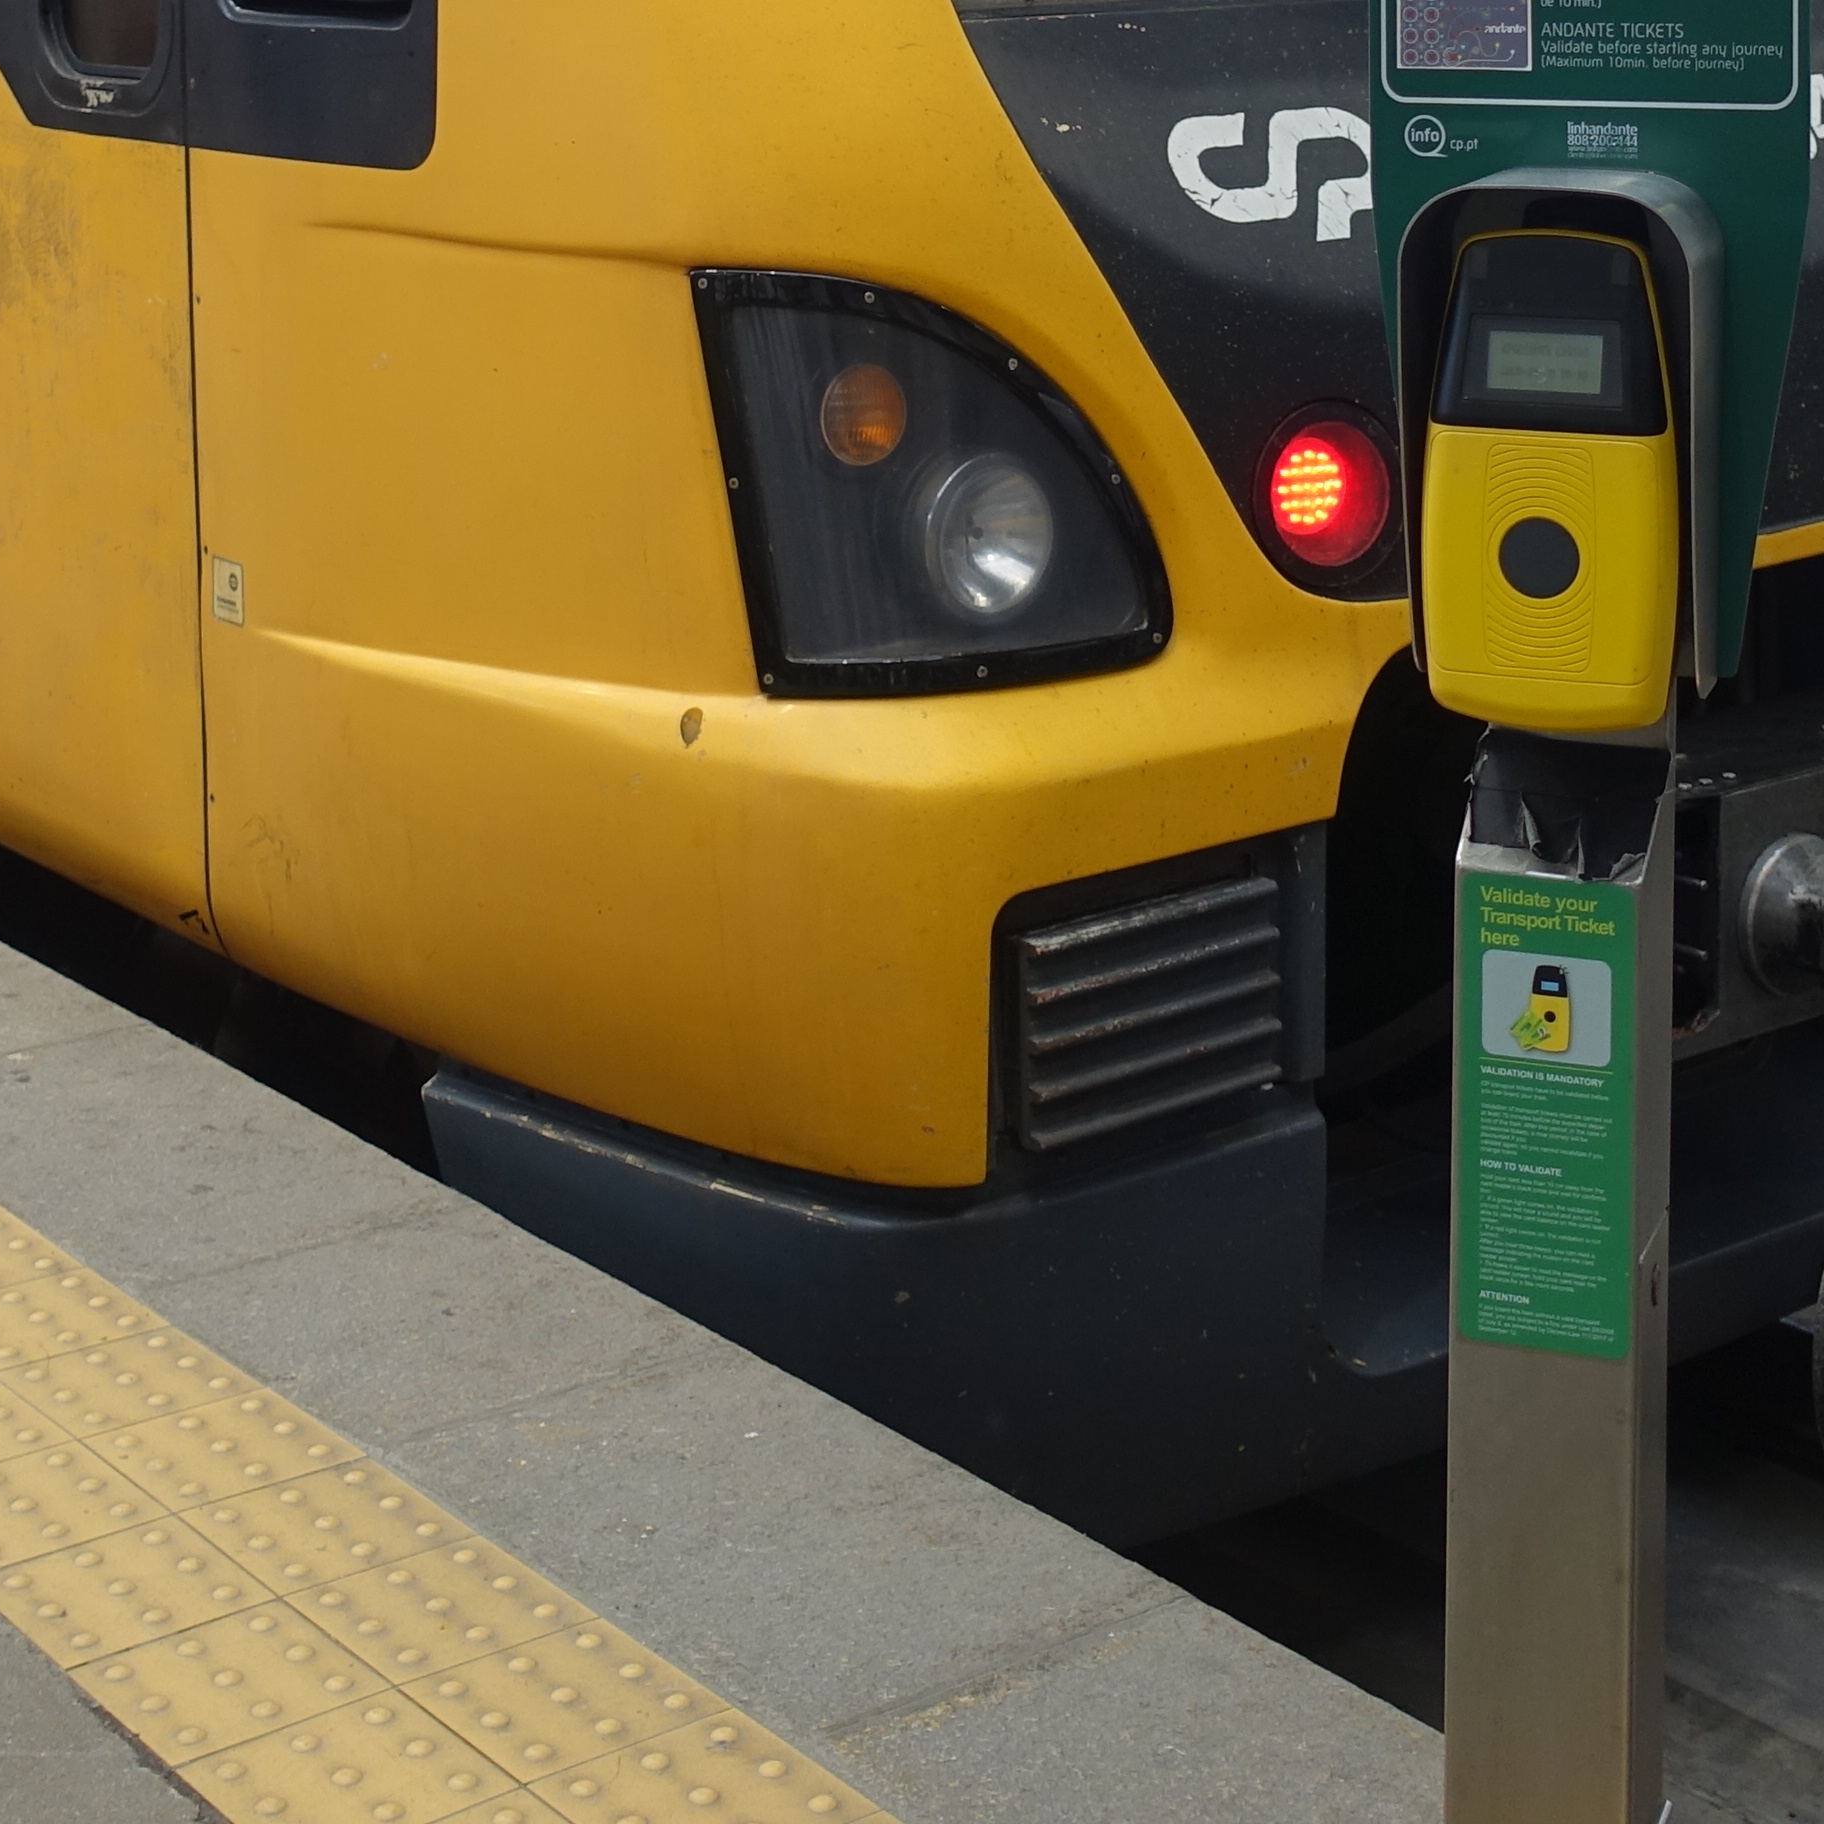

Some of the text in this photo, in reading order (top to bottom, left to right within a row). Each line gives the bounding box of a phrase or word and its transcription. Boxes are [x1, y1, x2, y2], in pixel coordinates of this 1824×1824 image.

[1484, 22, 1526, 34] andante
[1541, 22, 1683, 38] ANDANTE TICKETS
[1540, 40, 1783, 59] Validate before starting any journey
[1541, 55, 1745, 71] (Maximum 10min. before journey)
[1410, 128, 1440, 143] info
[1567, 121, 1638, 136] linhandante
[1449, 138, 1479, 152] cp.pt
[1480, 885, 1597, 913] Validate your
[1479, 906, 1615, 936] Transport Ticket
[1480, 926, 1519, 946] here
[1480, 1065, 1604, 1087] VALIDATION IS MANDATORY
[1480, 1158, 1561, 1177] HOW TO VALIDATE
[1478, 1289, 1529, 1304] ATTENTION
